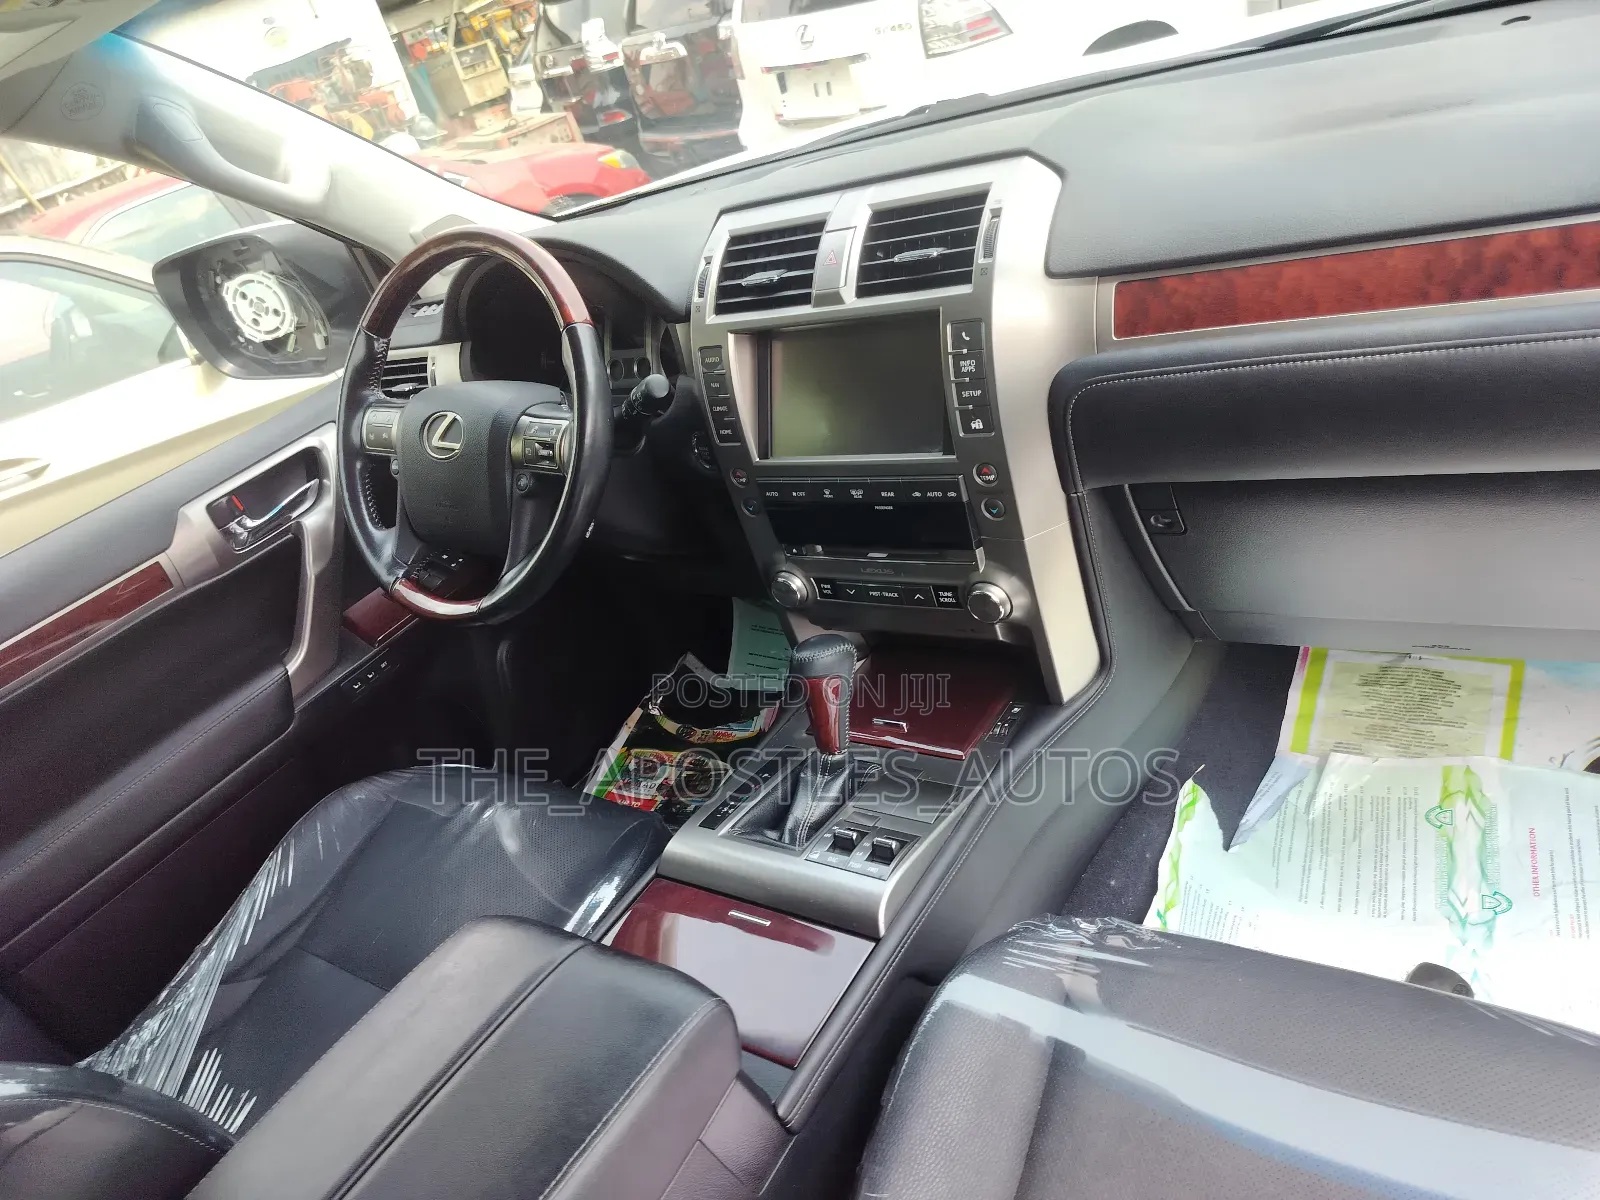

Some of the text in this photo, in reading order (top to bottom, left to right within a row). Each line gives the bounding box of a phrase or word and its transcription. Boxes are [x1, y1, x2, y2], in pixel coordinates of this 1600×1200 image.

[704, 356, 720, 364] AUDIO
[961, 389, 982, 398] SETUP
[860, 567, 895, 575] LEXUS
[1528, 826, 1541, 898] OTHER INFORMATION
